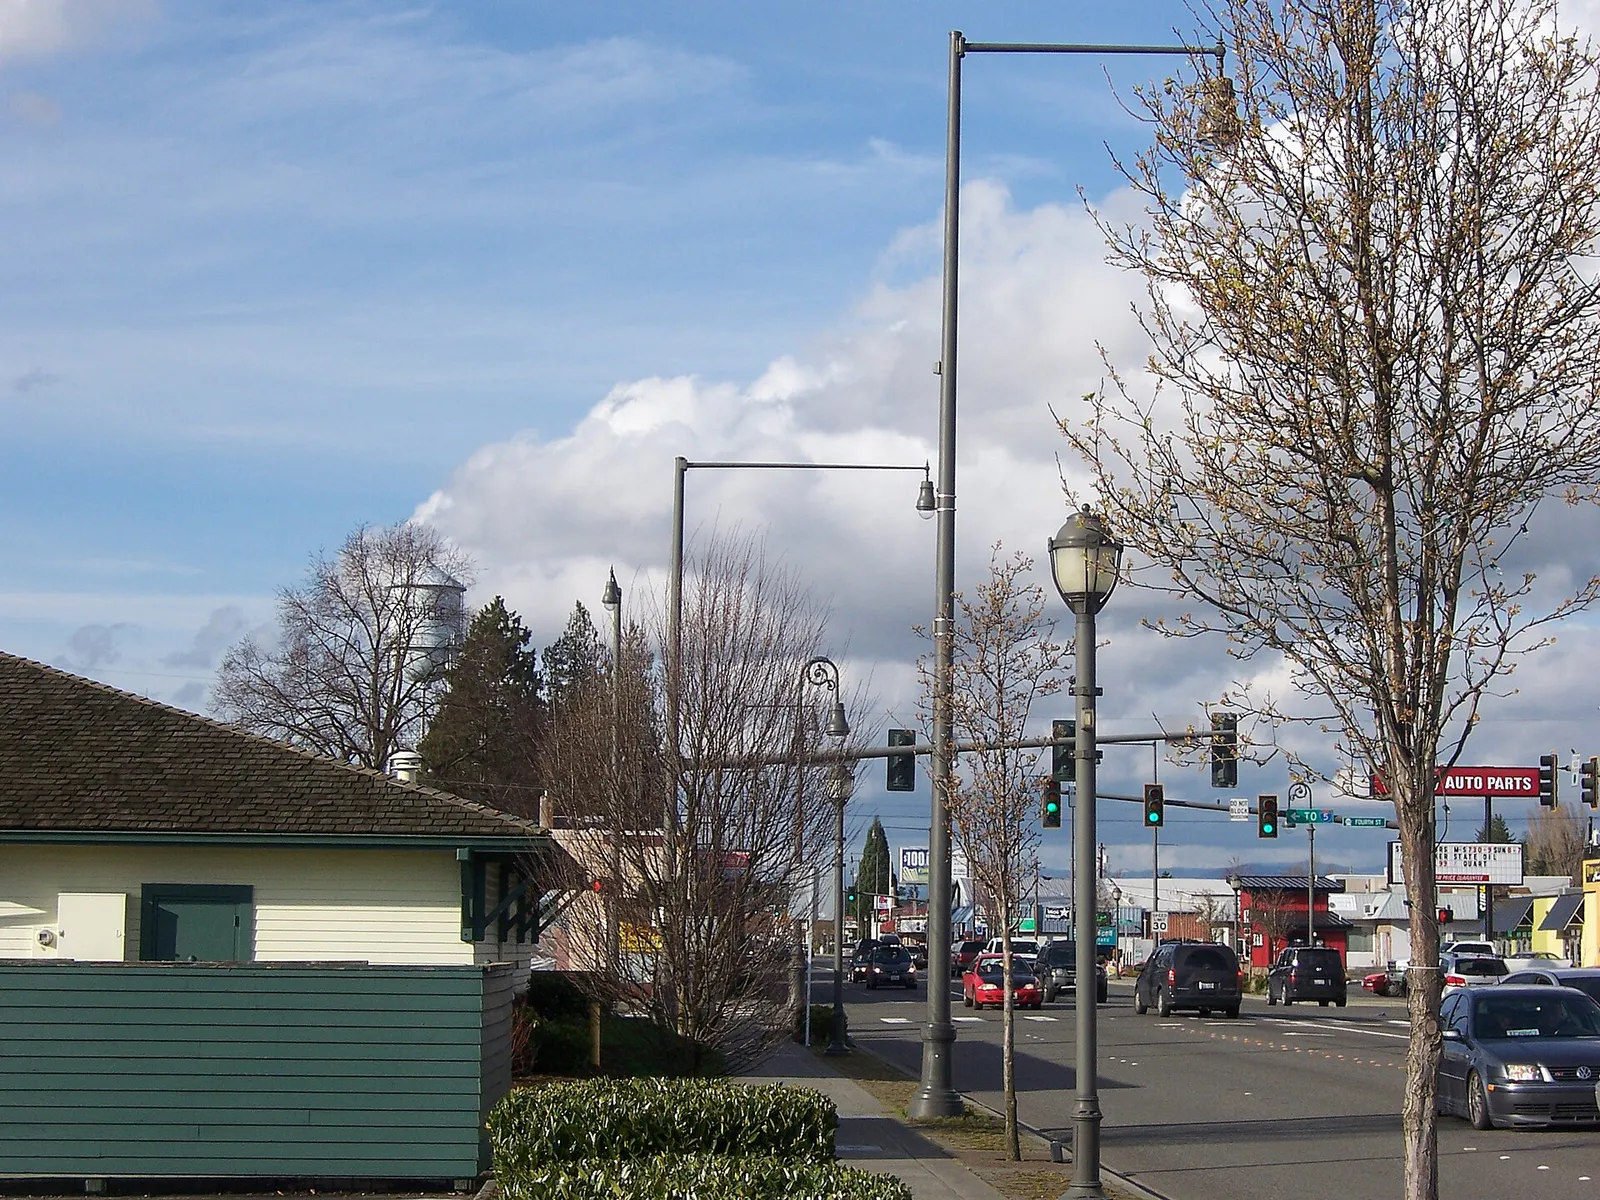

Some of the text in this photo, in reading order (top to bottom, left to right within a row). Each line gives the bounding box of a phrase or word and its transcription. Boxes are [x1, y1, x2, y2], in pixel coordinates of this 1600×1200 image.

[1445, 776, 1482, 790] AUTO
[1487, 776, 1532, 790] PARTS
[1304, 812, 1317, 821] TO
[1153, 922, 1168, 930] 30
